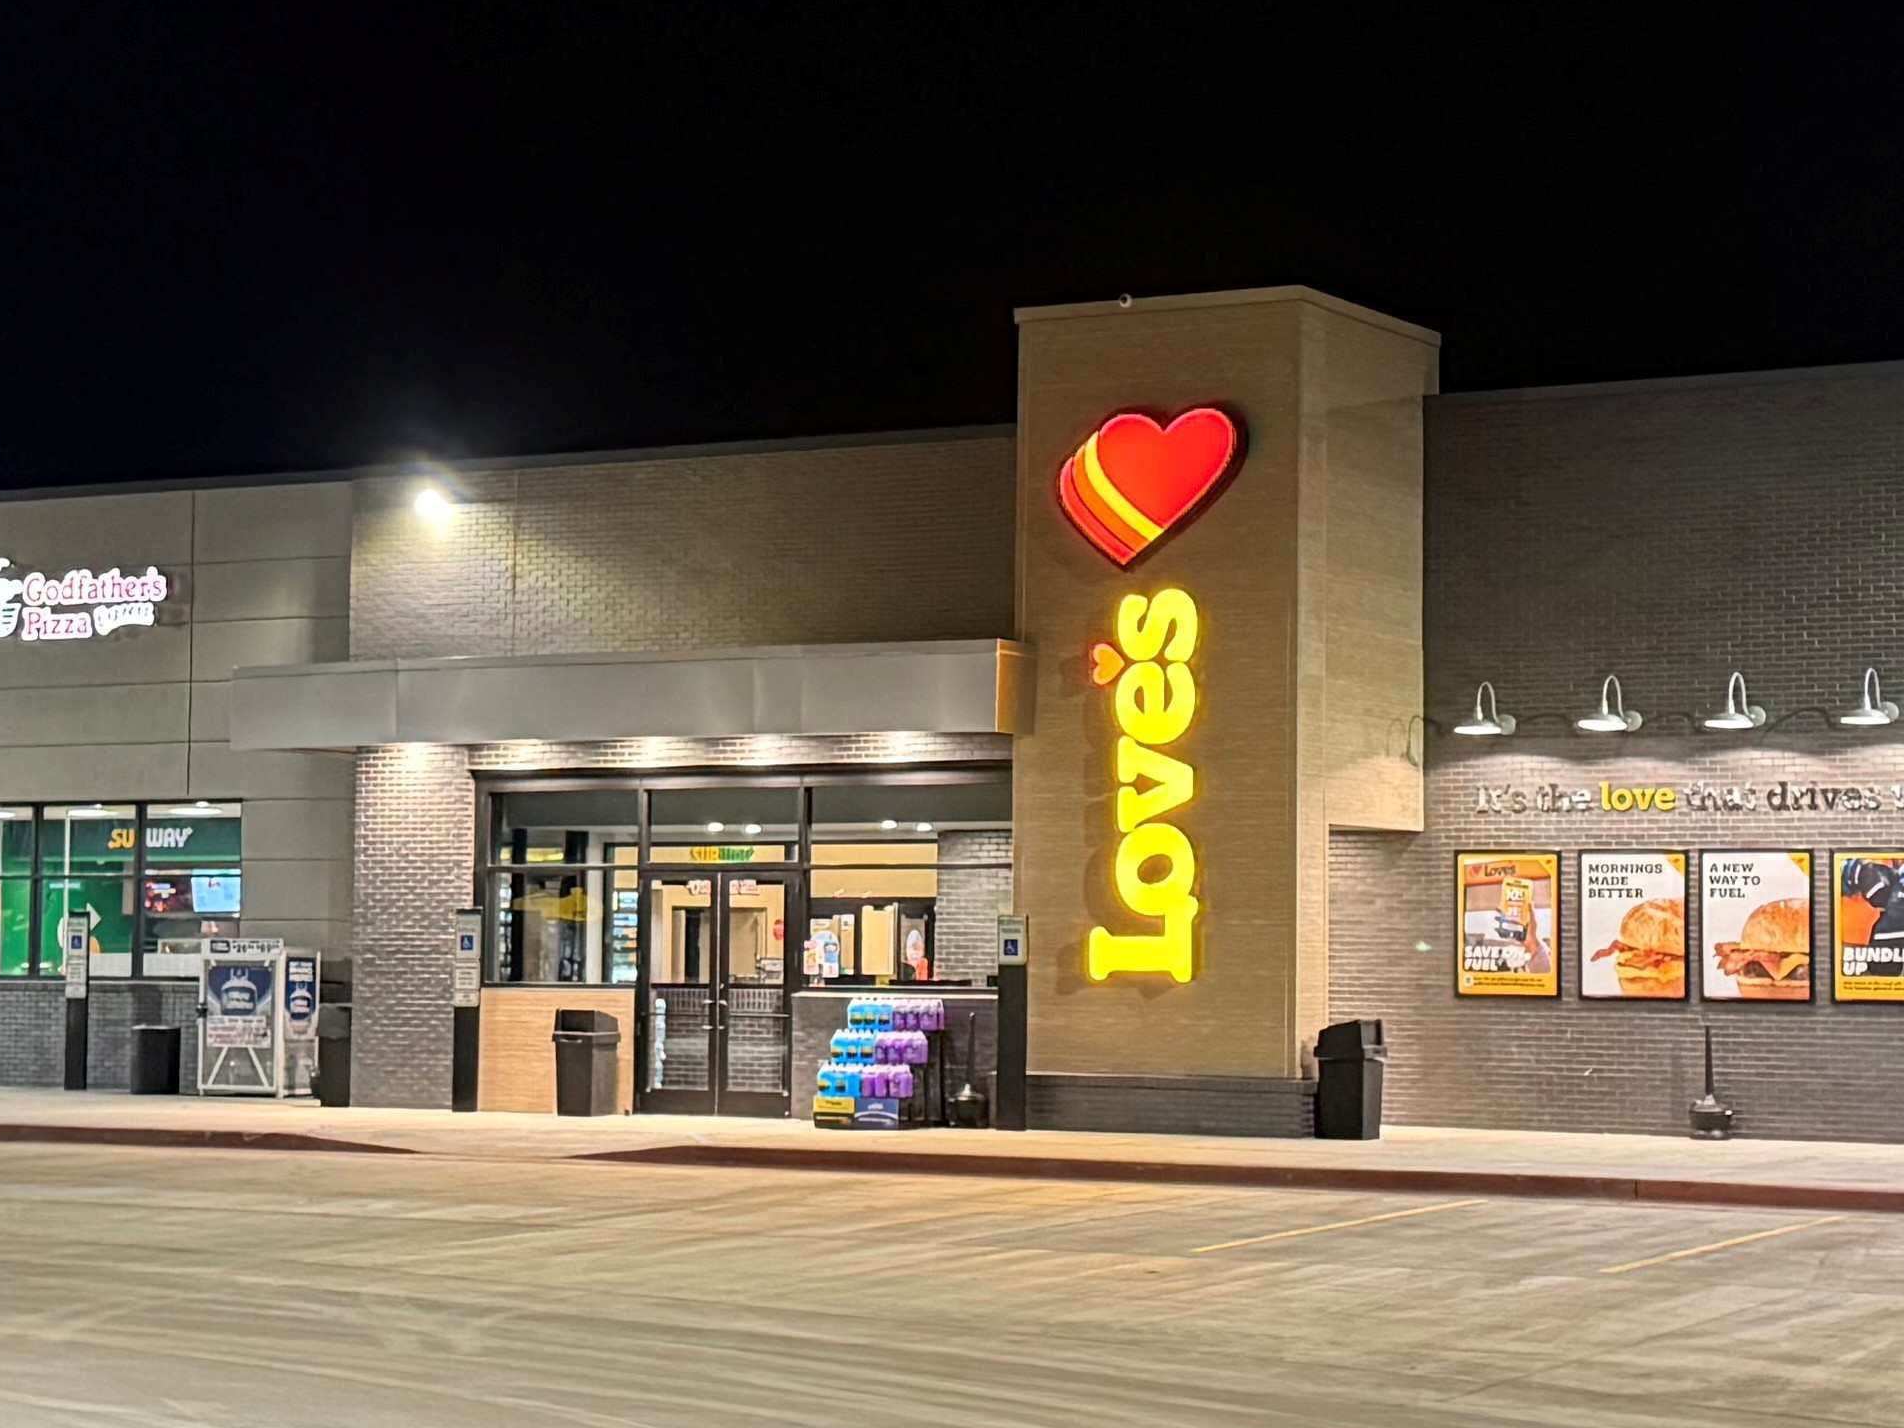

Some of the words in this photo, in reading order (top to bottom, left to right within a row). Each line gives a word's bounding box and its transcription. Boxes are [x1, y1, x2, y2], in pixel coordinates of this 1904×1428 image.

[24, 572, 165, 604] Godfather's
[25, 609, 90, 637] Pizza
[1475, 782, 1528, 814] It's
[1536, 782, 1592, 813] the
[1599, 780, 1677, 811] love
[1684, 779, 1757, 812] that
[1766, 780, 1882, 812] drives
[1587, 863, 1663, 874] MORNINGS
[1709, 863, 1718, 873] A
[1723, 863, 1755, 873] NEW
[1587, 876, 1629, 886] MADE
[1709, 875, 1738, 886] WAY
[1743, 875, 1761, 886] TO
[1587, 888, 1644, 899] BETTER
[1709, 888, 1746, 899] FUEL
[1463, 946, 1500, 959] SAVE
[1842, 962, 1868, 976] UP
